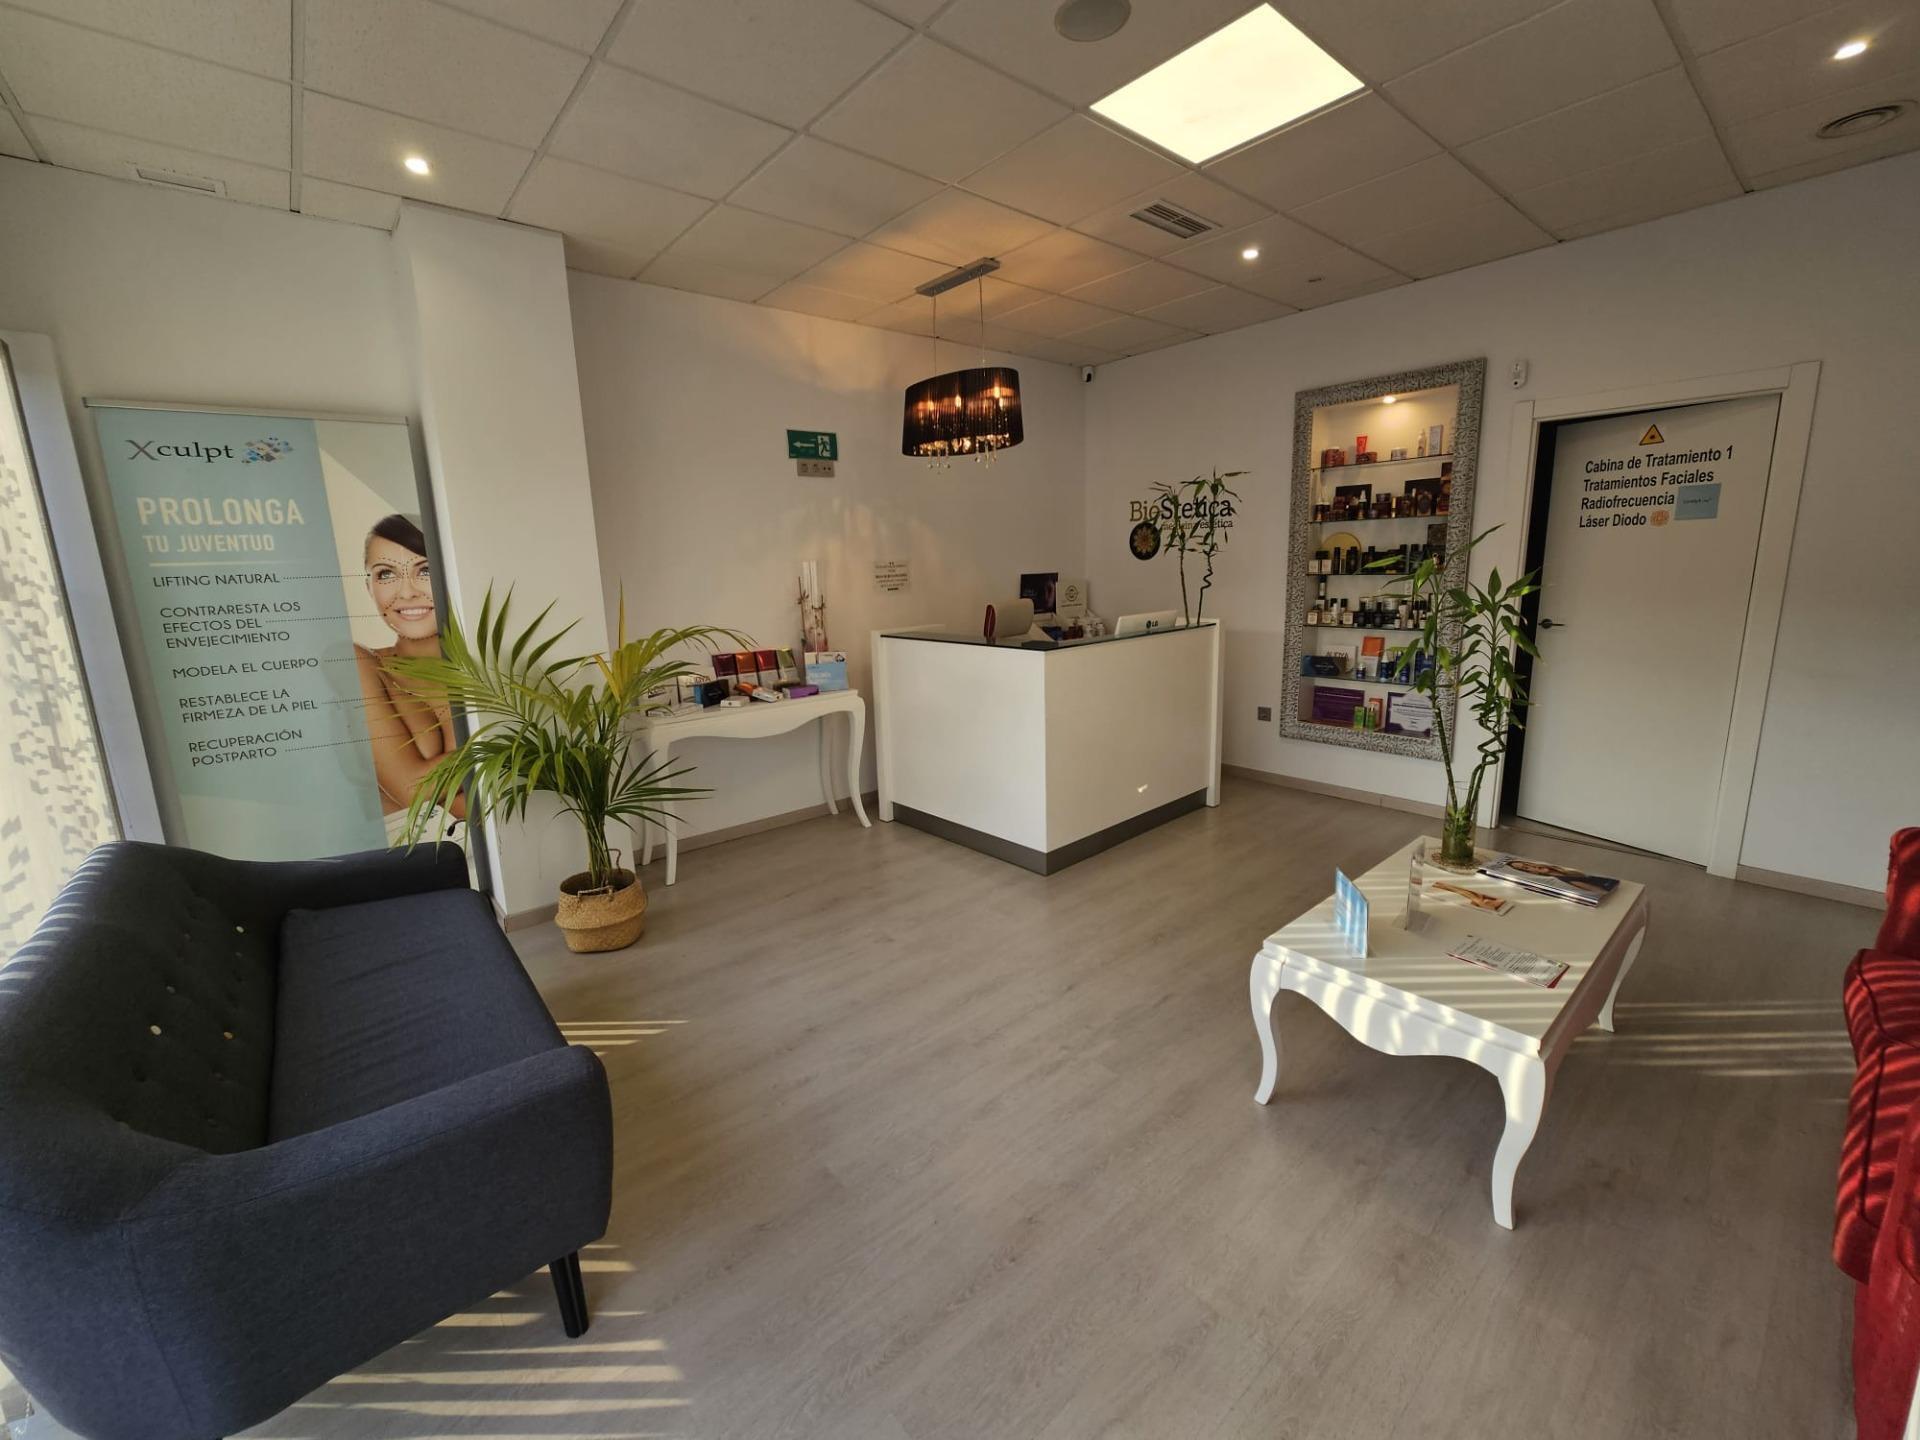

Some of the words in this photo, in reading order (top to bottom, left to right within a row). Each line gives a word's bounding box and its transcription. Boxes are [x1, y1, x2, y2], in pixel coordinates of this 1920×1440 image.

[125, 439, 235, 463] Xculpt
[1585, 458, 1624, 474] Cabina
[1627, 456, 1642, 470] de
[1645, 448, 1722, 467] Tratamiento
[1726, 444, 1734, 460] 1
[1583, 475, 1657, 492] Tratamientos
[1660, 469, 1715, 486] Faciales
[136, 497, 305, 526] PROLONGA
[1129, 496, 1233, 522] BioSetica
[1581, 492, 1676, 510] Radiofrecuencia
[1579, 513, 1610, 529] Láser
[1612, 513, 1647, 528] Diodo
[142, 534, 170, 552] TU
[176, 534, 275, 552] JUVENTUD
[153, 575, 210, 587] LIFTING
[215, 573, 280, 585] NATURAL
[160, 603, 270, 618] CONTRARESTA
[273, 601, 301, 613] LOS
[163, 620, 232, 633] EFECTOS
[236, 618, 262, 630] DEL
[166, 631, 290, 649] ENVEJECIMIENTO
[172, 664, 238, 679] MODELA
[242, 662, 258, 673] EL
[261, 657, 319, 671] CUERPO
[179, 690, 269, 709] RESTABLECE
[272, 688, 291, 699] LA
[182, 707, 245, 723] FIRMEZA
[249, 704, 267, 716] DE
[271, 702, 289, 713] LA
[292, 700, 318, 711] PIEL
[189, 729, 302, 752] RECUPERACIÓN
[192, 747, 277, 767] POSTPARTO
